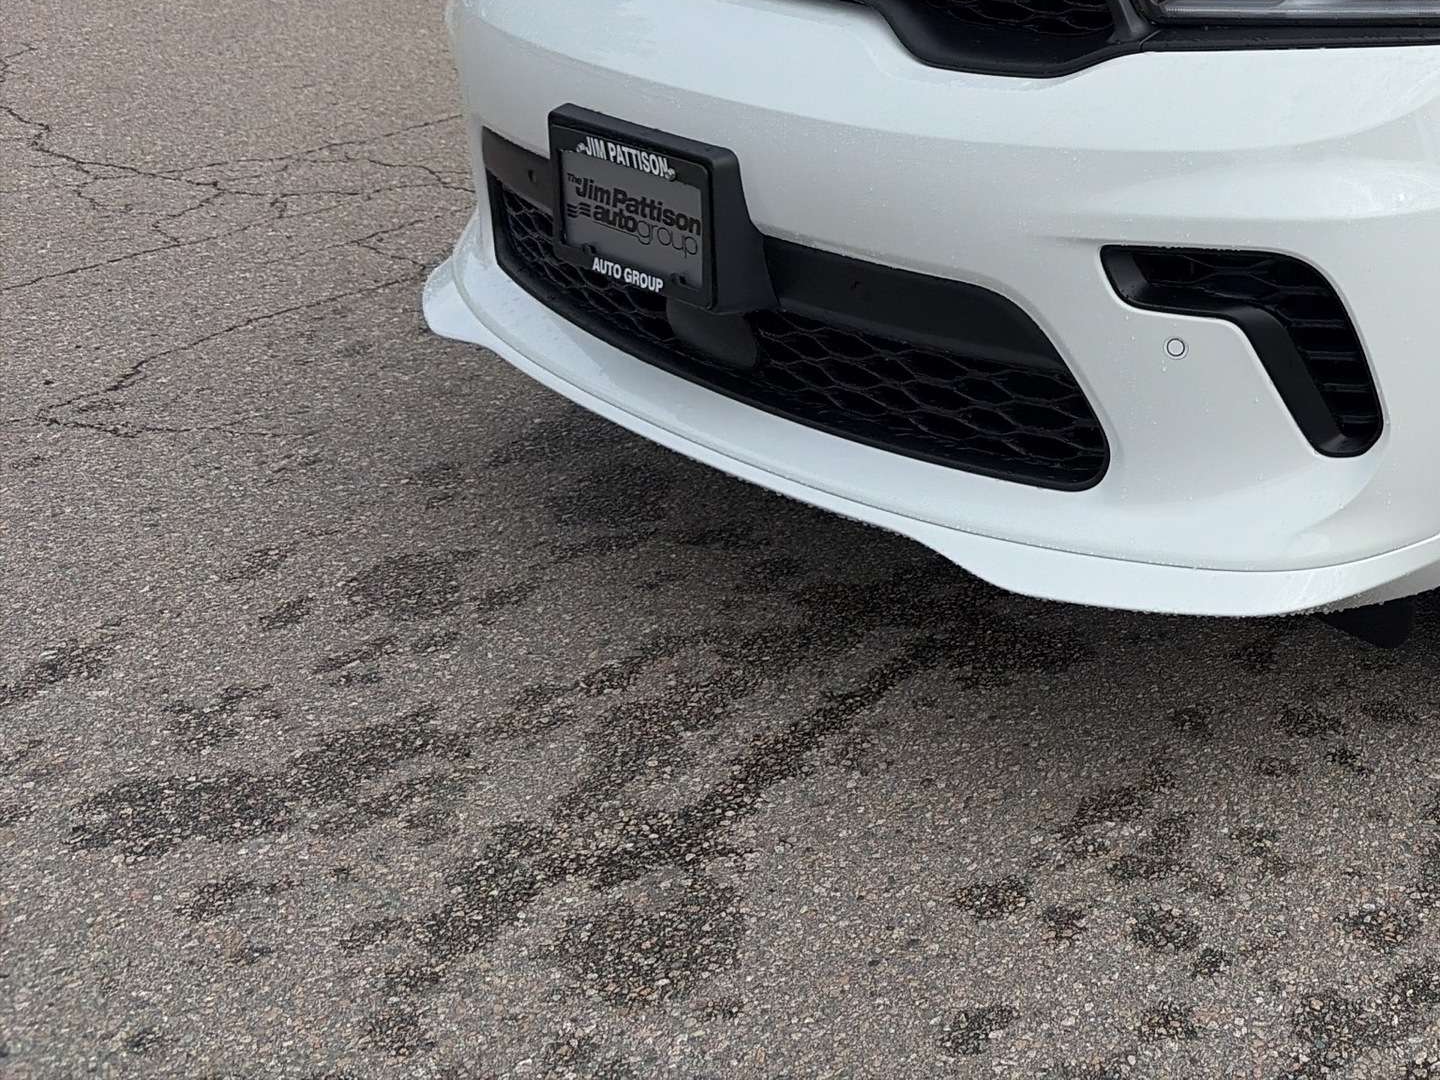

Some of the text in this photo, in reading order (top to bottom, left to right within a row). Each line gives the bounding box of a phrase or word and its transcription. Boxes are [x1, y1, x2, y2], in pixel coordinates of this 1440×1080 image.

[584, 136, 669, 178] JIM PATTISON
[567, 172, 583, 186] The
[592, 256, 664, 294] AUTO GROUP
